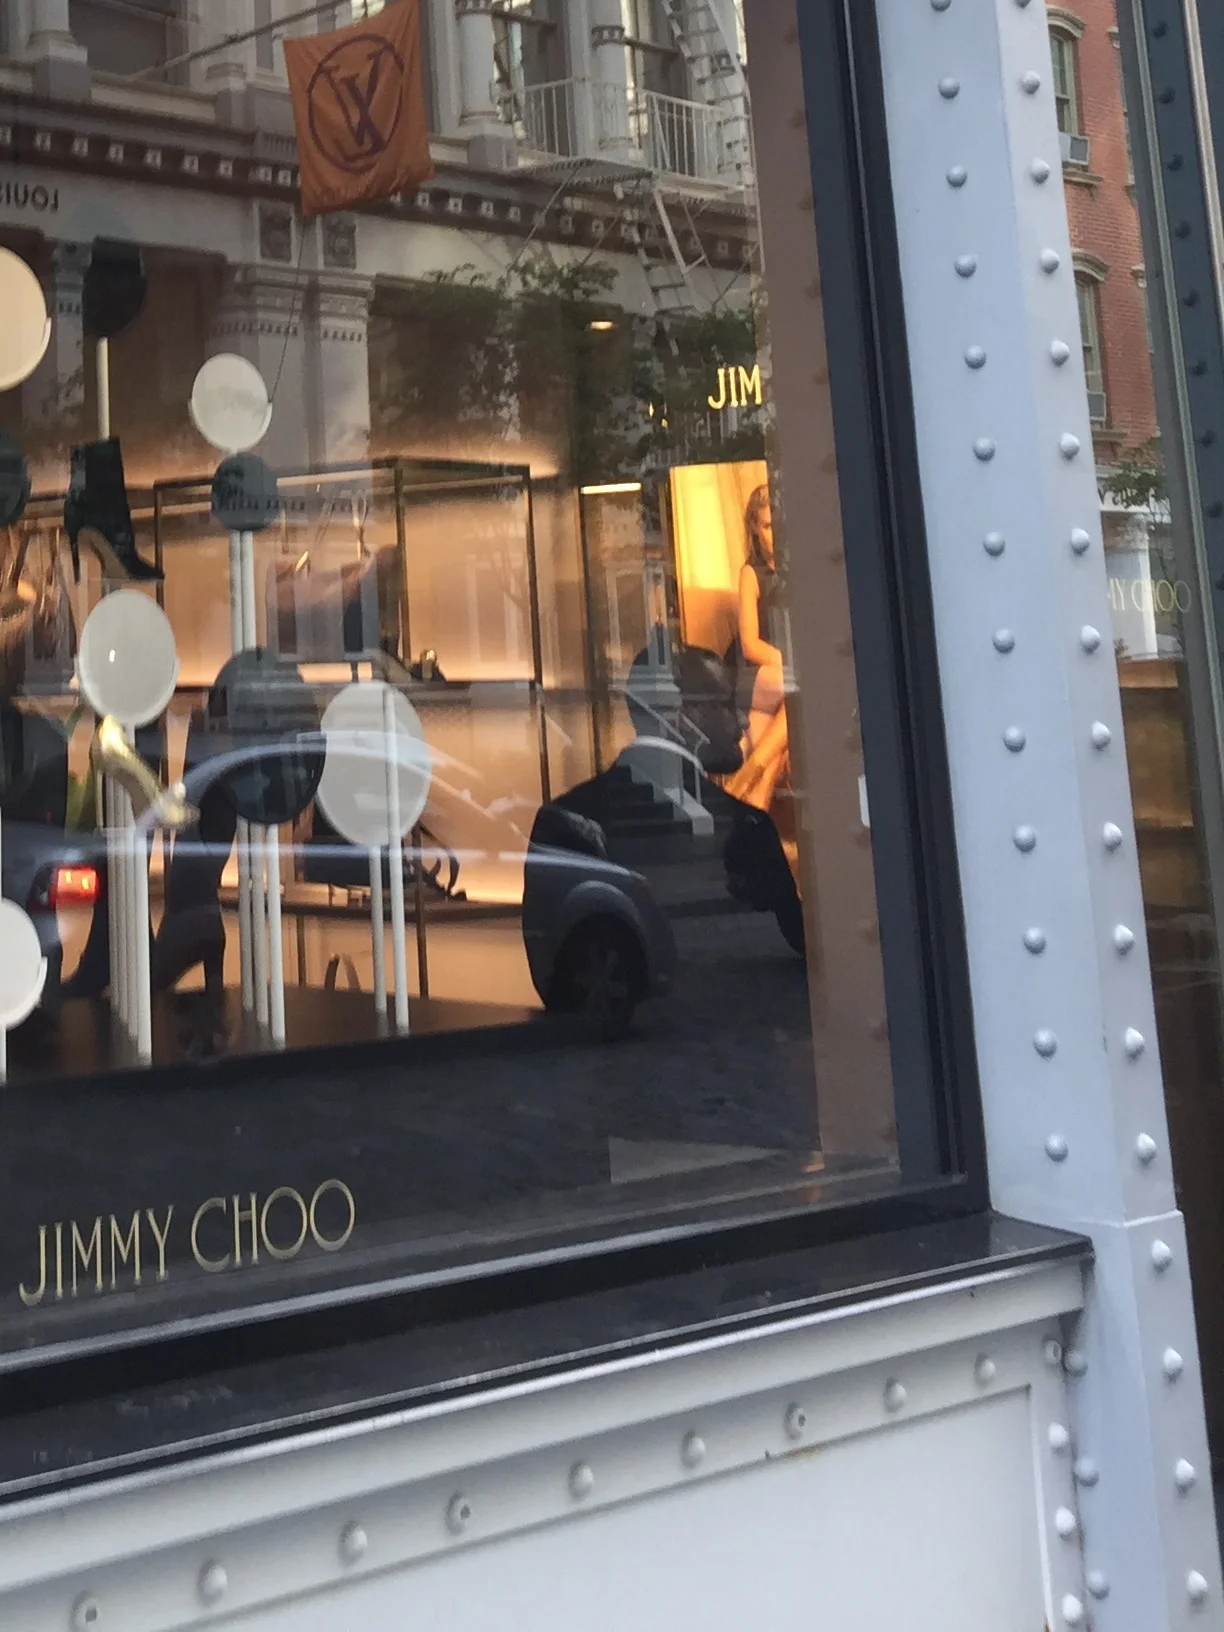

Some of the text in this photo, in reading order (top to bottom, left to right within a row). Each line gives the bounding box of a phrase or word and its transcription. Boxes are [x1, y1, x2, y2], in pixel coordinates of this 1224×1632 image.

[707, 363, 762, 409] JIM
[19, 1178, 356, 1307] JIMMY CHOO
